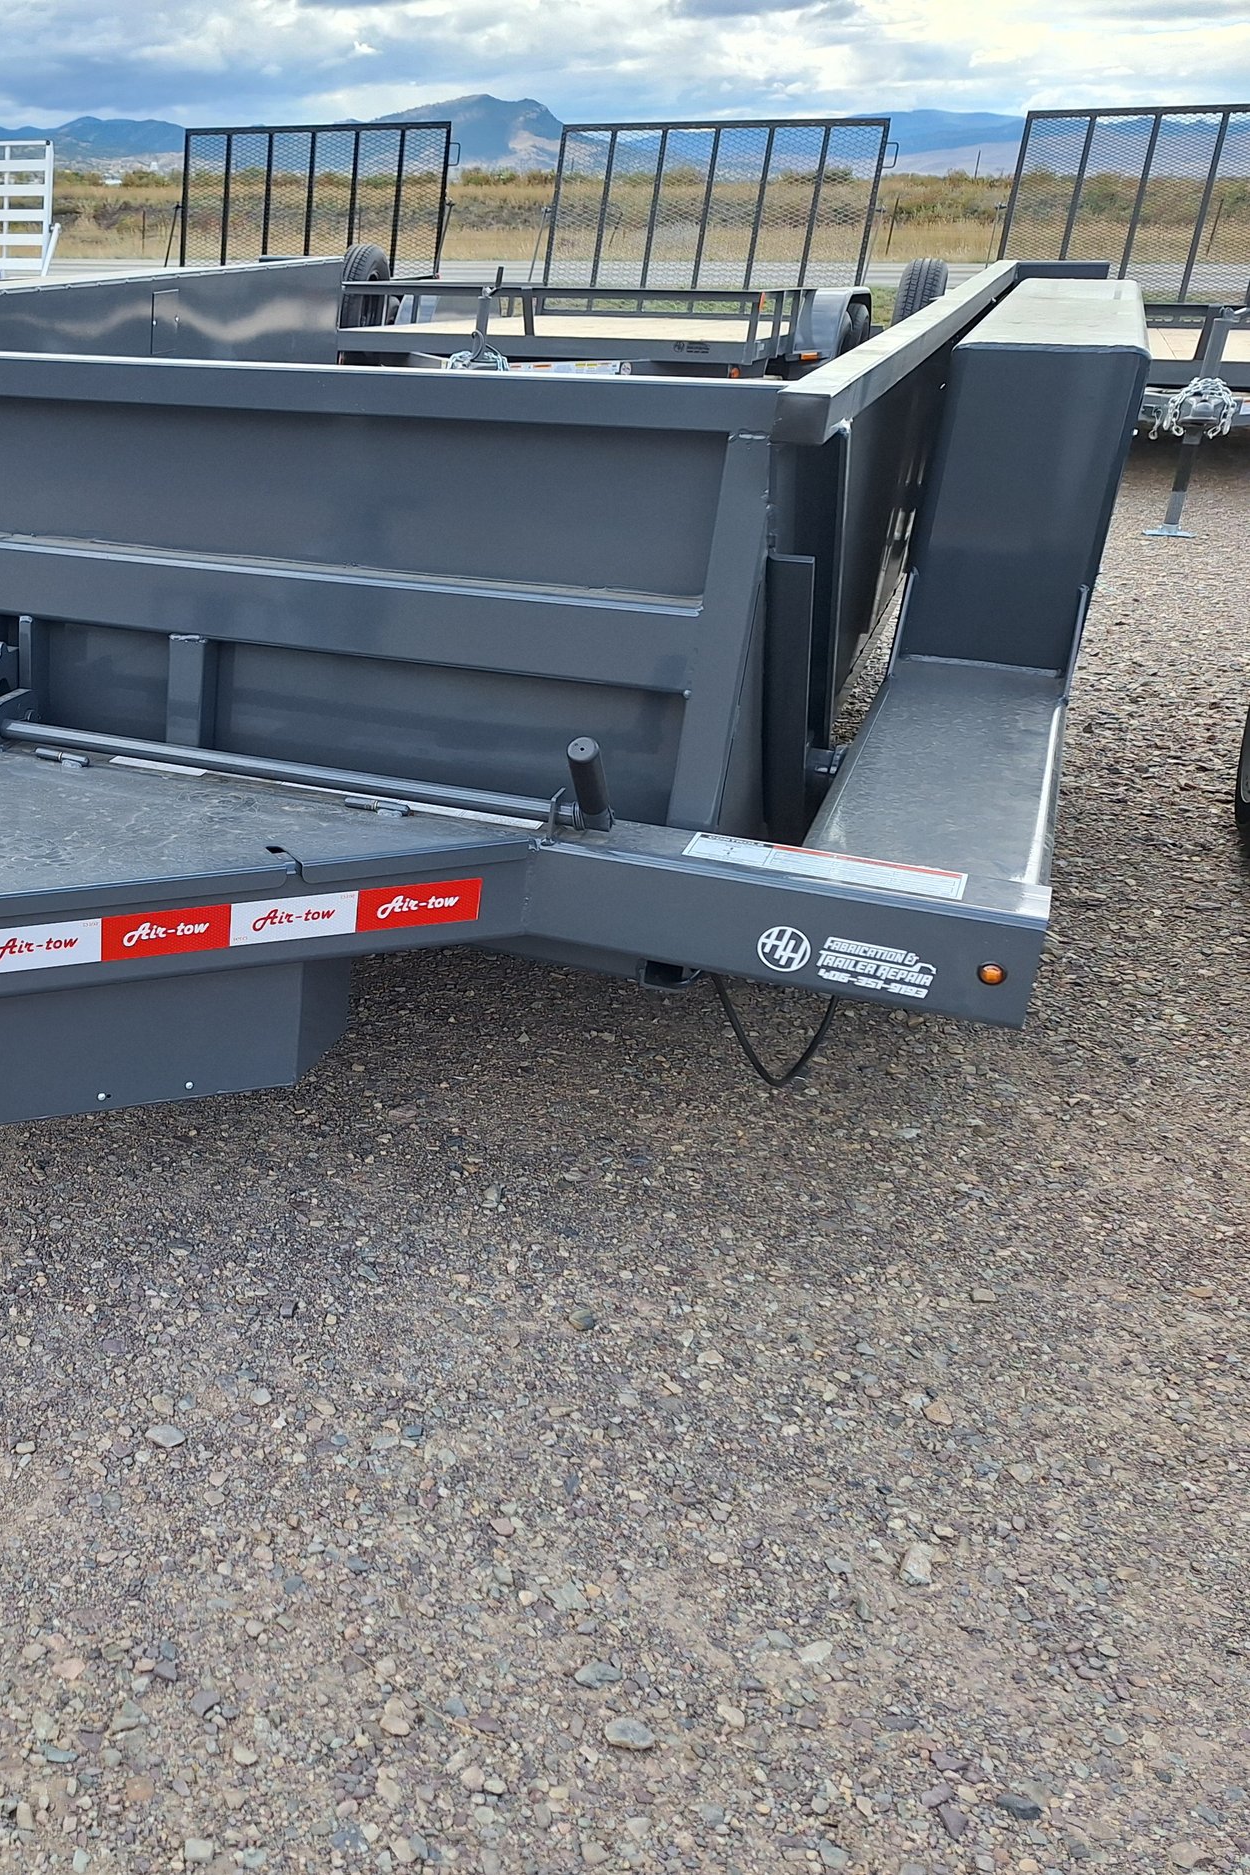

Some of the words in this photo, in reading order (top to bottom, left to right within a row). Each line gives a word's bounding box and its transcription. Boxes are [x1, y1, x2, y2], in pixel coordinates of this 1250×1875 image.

[252, 908, 336, 933] Air-tow
[376, 895, 459, 920] Air-tow
[122, 921, 210, 947] Air-tow
[823, 936, 907, 963] FABRICATION
[816, 950, 878, 976] TRAILER
[876, 966, 934, 987] REPAIR
[817, 968, 929, 999] 406-351-9193
